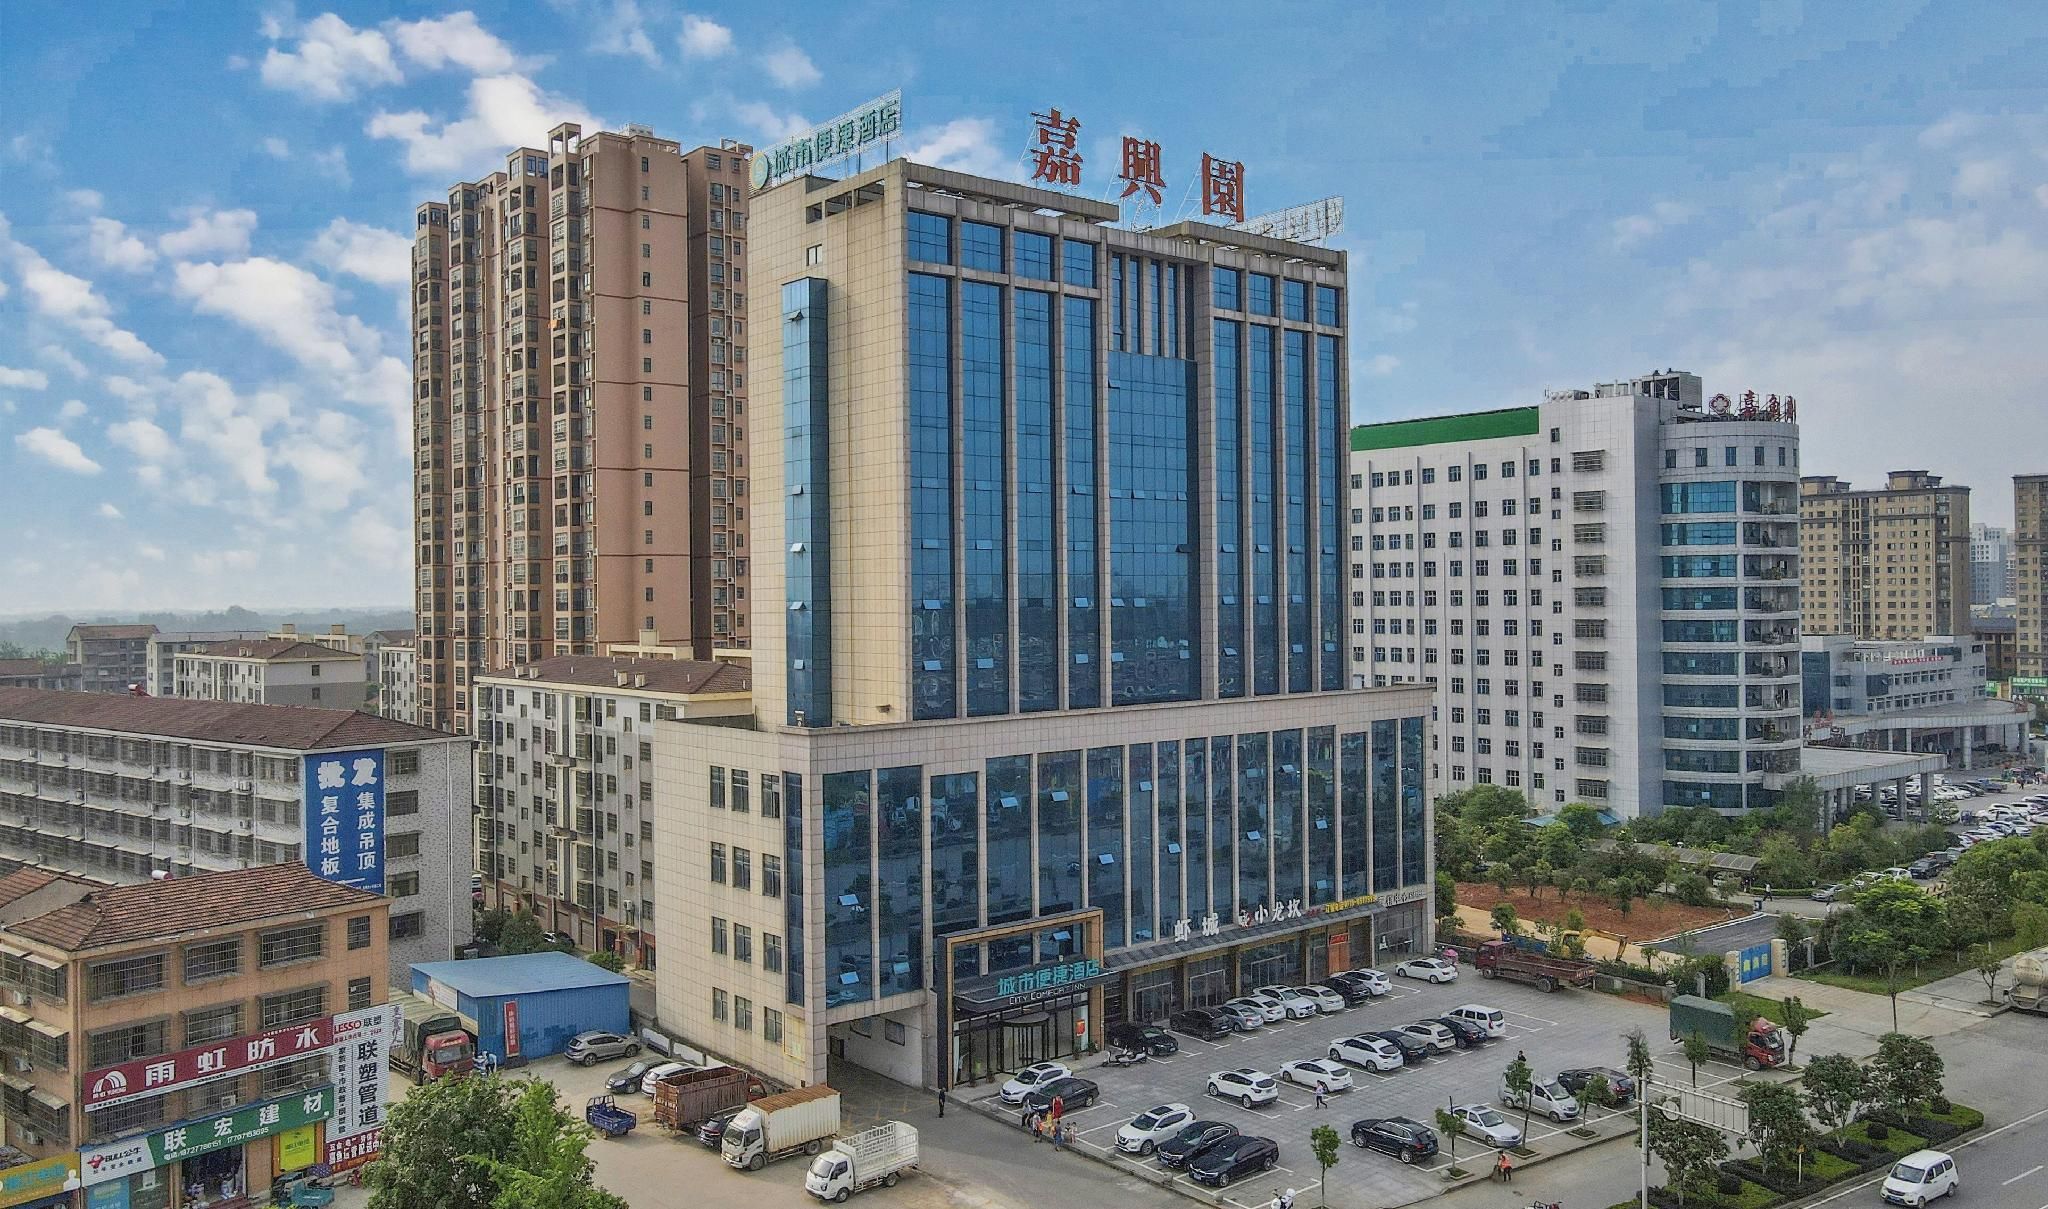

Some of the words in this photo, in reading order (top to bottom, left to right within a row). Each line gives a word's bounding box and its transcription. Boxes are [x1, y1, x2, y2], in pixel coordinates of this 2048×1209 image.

[772, 99, 897, 178] 城市便捷酒店
[1030, 107, 1245, 223] 嘉興園
[321, 795, 341, 876] 复合地板
[356, 791, 377, 871] 集成吊顶
[1174, 912, 1220, 943] 虾城
[1254, 898, 1302, 925] 小龙坎
[997, 959, 1100, 996] 城市便捷酒店
[1009, 994, 1028, 1005] CITY
[1072, 982, 1086, 991] INN
[334, 1020, 362, 1035] LESSO
[363, 1015, 382, 1028] 联塑
[145, 1027, 321, 1087] 雨虹防水
[357, 1039, 379, 1127] 联塑管道
[163, 1092, 324, 1153] 联宏建材
